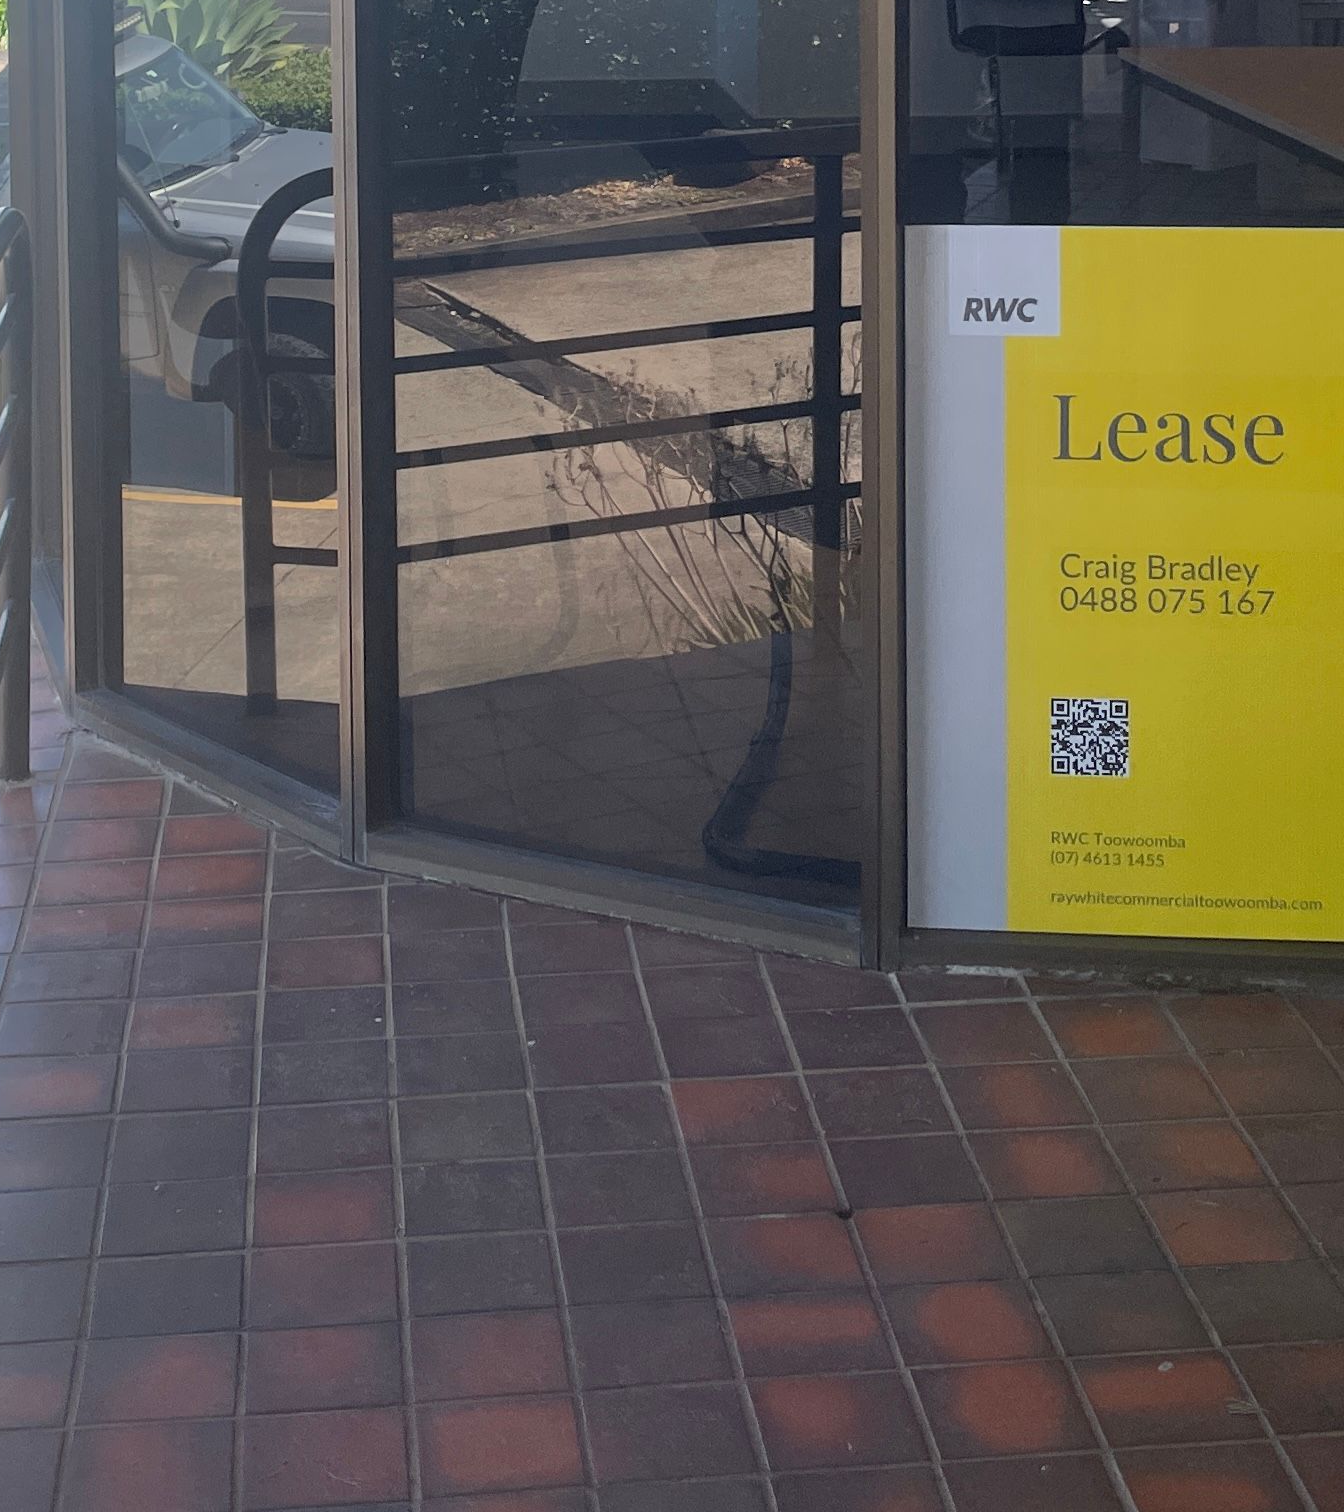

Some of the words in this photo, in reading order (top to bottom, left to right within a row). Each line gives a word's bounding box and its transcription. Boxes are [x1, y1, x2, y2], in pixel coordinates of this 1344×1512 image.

[963, 297, 1038, 322] RWC
[1052, 394, 1285, 465] Lease
[1060, 553, 1136, 585] Craig
[1147, 554, 1260, 586] Bradley
[1060, 587, 1137, 613] 0488
[1148, 589, 1205, 614] 075
[1219, 590, 1275, 615] 167
[1051, 831, 1089, 845] RWC
[1094, 832, 1186, 848] Toowoomba
[1050, 851, 1079, 866] (07)
[1083, 851, 1121, 866] 4613
[1127, 852, 1165, 867] 1455
[1051, 891, 1323, 911] raywhitecommercialtoowoomba.com
